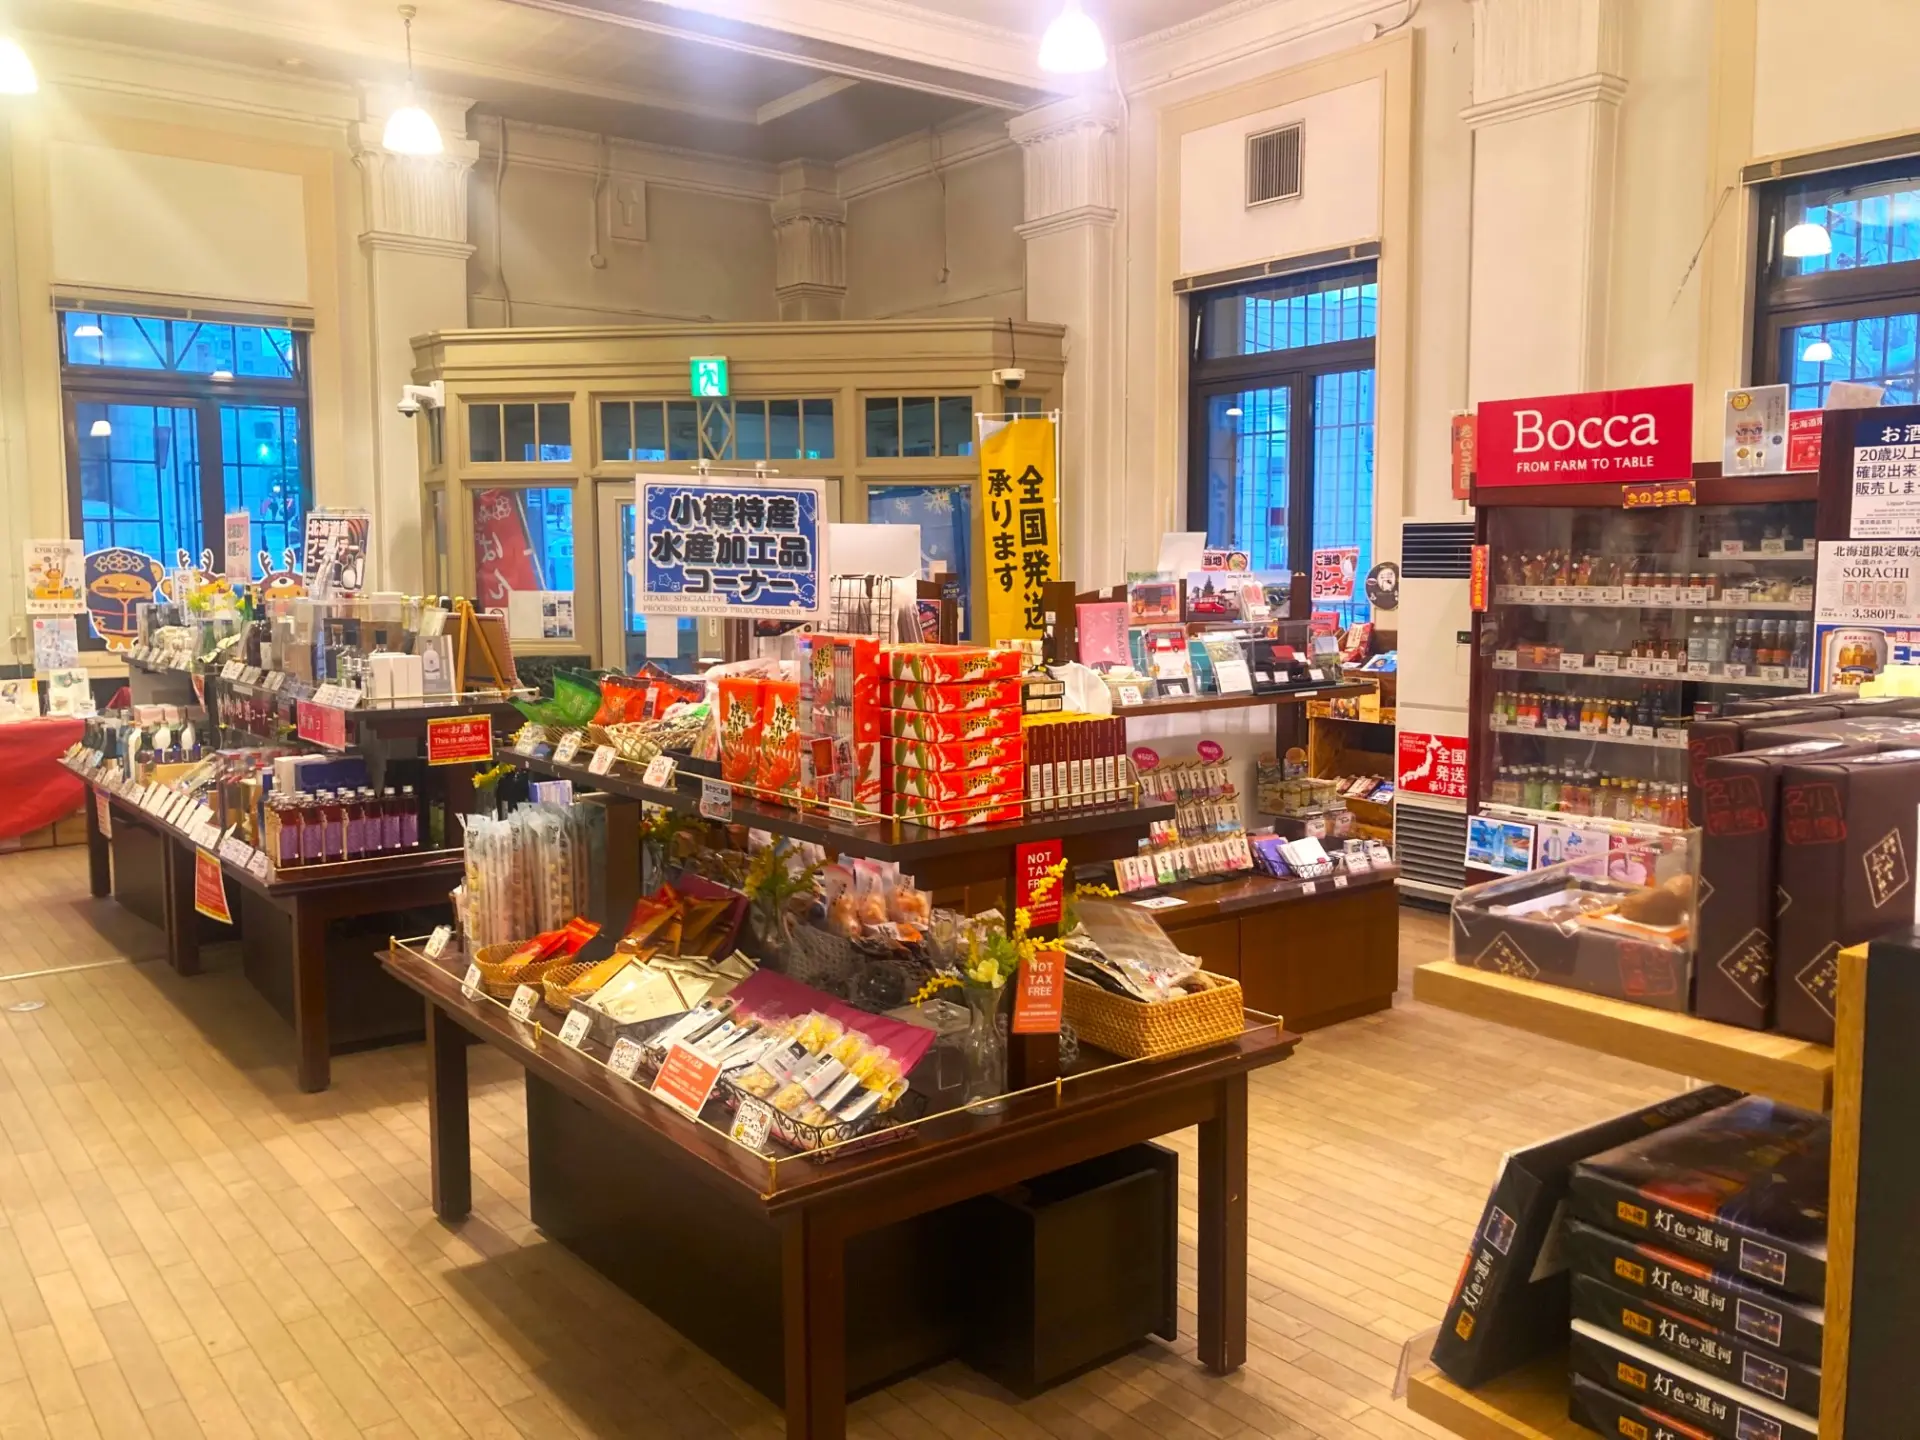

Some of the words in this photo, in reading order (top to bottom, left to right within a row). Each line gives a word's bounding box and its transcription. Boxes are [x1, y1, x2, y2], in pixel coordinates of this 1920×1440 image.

[1513, 409, 1659, 453] Bocca
[1516, 460, 1549, 473] FROM
[1554, 458, 1587, 471] FARM
[1591, 457, 1610, 469] TO
[1614, 455, 1654, 468] TABLE
[1856, 464, 1920, 479] 確認出来
[670, 493, 798, 529] 小樽特産
[988, 469, 1018, 593] 承ります
[651, 531, 809, 568] 水産加工品
[1017, 464, 1051, 632] 全国発送
[1315, 554, 1341, 566] ご当地
[1315, 570, 1340, 581] カレー
[1843, 567, 1909, 579] SORACHI
[684, 569, 796, 598] コーナー
[1315, 584, 1346, 595] コーナー
[675, 595, 722, 603] SPECIALITY
[643, 604, 688, 612] PROCESSED
[691, 605, 728, 613] SEAFOOD
[731, 606, 770, 614] PRODUCTS
[770, 608, 801, 616] CORNER
[1852, 607, 1896, 620] 3,380円
[1437, 747, 1466, 765] 全国
[1436, 765, 1466, 783] 発送
[1428, 780, 1468, 796] 承ります
[1027, 851, 1052, 865] NOT
[1030, 962, 1053, 973] NOT
[1029, 974, 1053, 985] TAX
[1027, 986, 1053, 997] FREE
[1654, 1209, 1730, 1252] 灯色の運河
[1651, 1266, 1727, 1312] 灯色の運河
[1658, 1318, 1733, 1365] 灯色の運河
[1652, 1372, 1728, 1421] 灯色の運河
